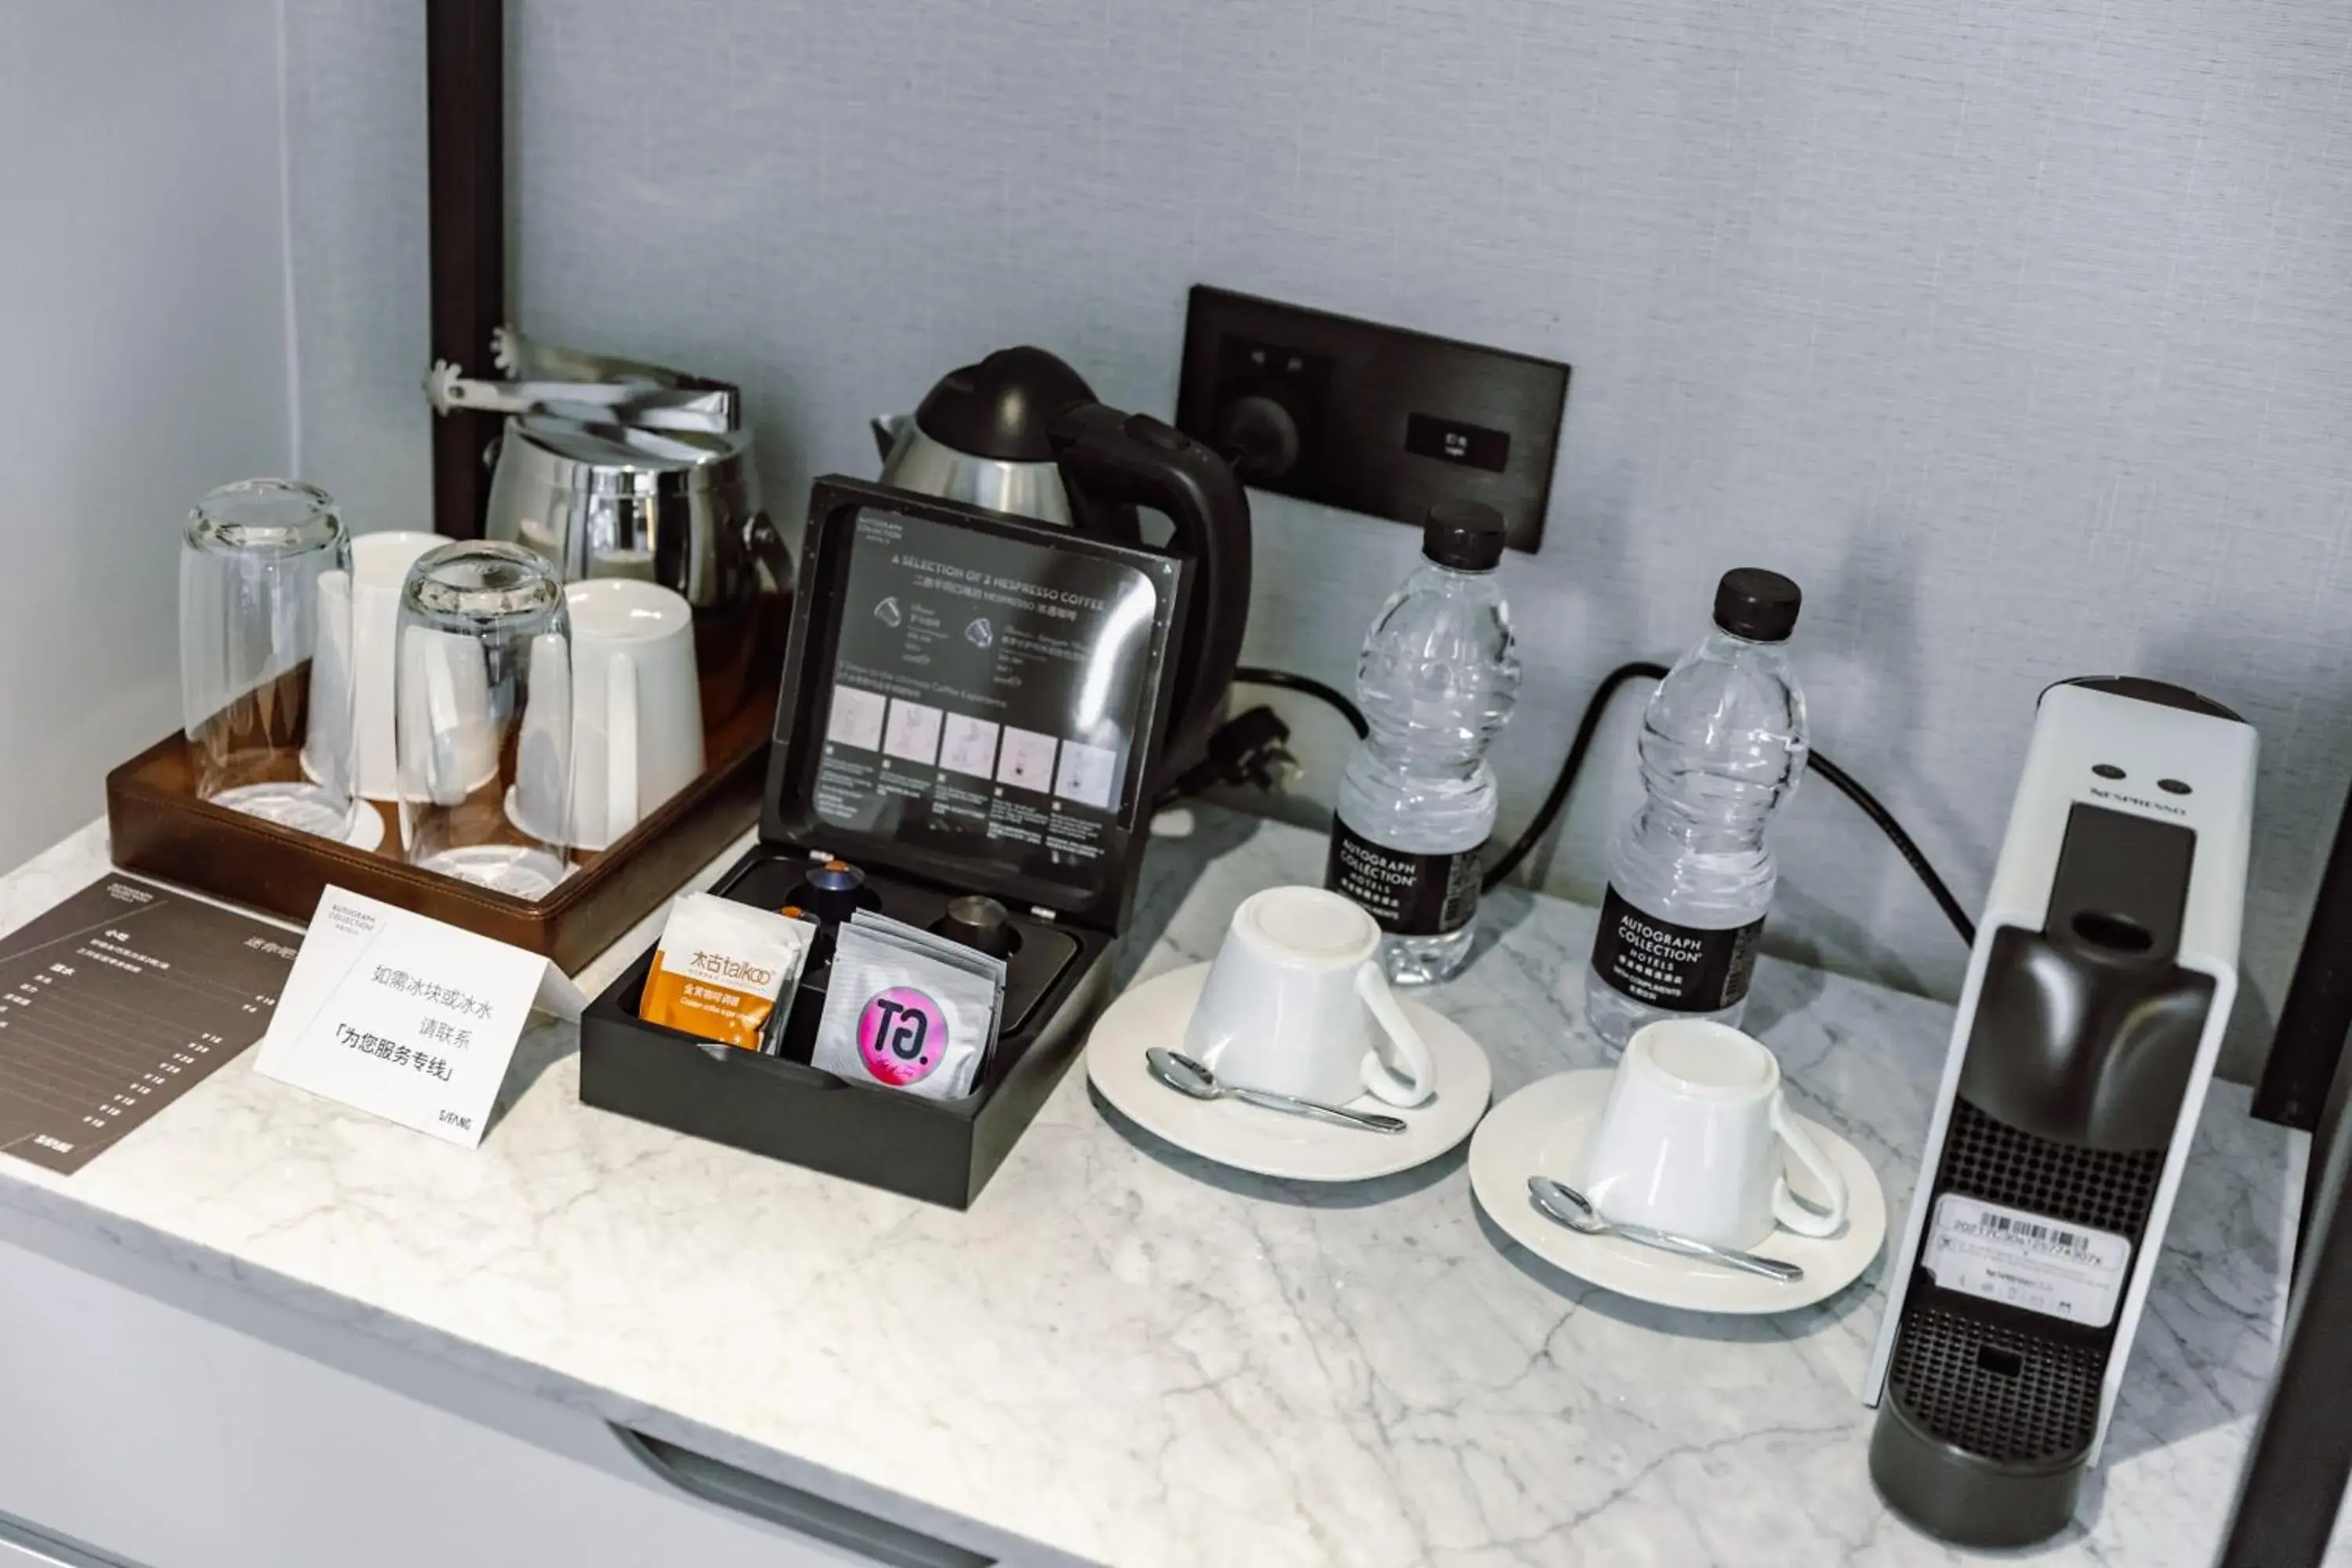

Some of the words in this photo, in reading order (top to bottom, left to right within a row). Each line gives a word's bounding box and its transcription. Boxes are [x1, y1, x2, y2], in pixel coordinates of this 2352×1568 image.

[891, 554, 900, 564] A
[902, 554, 964, 579] SELECTION
[965, 568, 982, 583] OF
[993, 576, 1059, 601] NESPRESSO
[1340, 849, 1414, 887] COLLECTION
[1343, 838, 1416, 874] AUTOGRAPH
[1618, 926, 1699, 963] COLLECTION
[1621, 915, 1702, 950] AUTOGRAPH
[1630, 948, 1675, 972] HOTELS
[371, 963, 494, 1021] 如需冰块或冰水
[418, 1015, 474, 1051] 请联系
